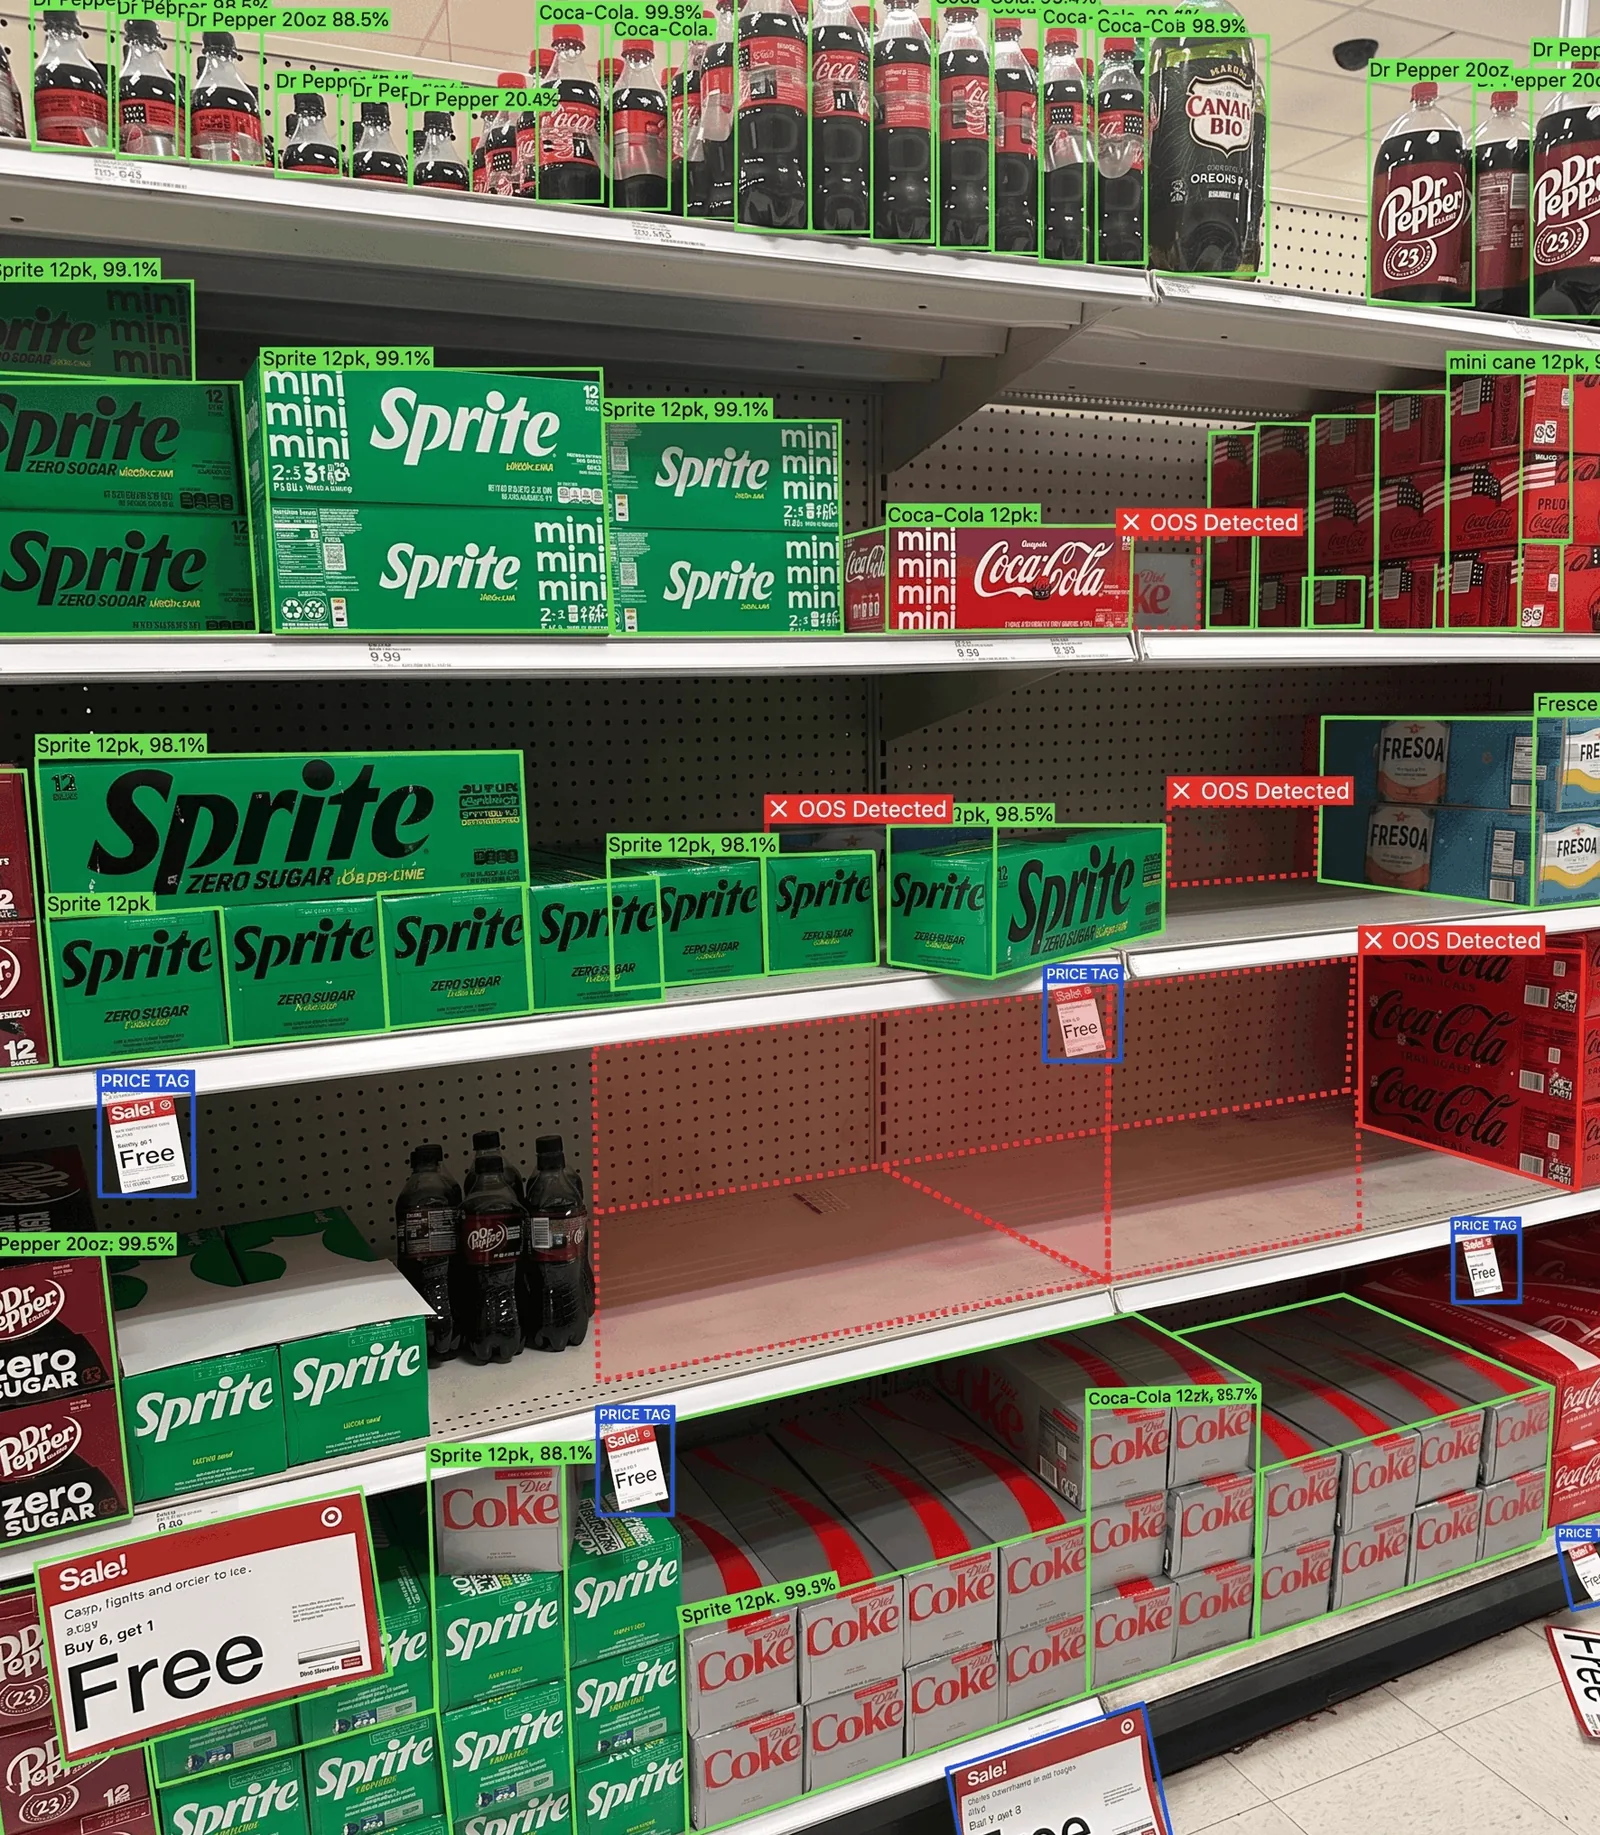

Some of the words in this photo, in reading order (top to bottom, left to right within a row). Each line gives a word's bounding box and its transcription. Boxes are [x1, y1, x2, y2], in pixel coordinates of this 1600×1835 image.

[1411, 176, 1449, 206] Dr
[1386, 187, 1463, 241] Pepper
[1398, 249, 1420, 268] 23
[1546, 232, 1570, 253] 23
[583, 385, 599, 399] 12
[266, 396, 347, 428] mini
[370, 387, 560, 466] Sprite
[269, 428, 349, 460] mini
[781, 424, 838, 450] mini
[26, 460, 65, 474] ZERO
[655, 446, 769, 497] Sprite
[783, 475, 838, 500] mini
[534, 516, 604, 544] mini
[1, 530, 207, 606] Sprite
[379, 543, 521, 600] Sprite
[537, 545, 605, 573] mini
[898, 553, 957, 578] mini
[539, 574, 606, 601] mini
[663, 560, 775, 610] Sprite
[898, 579, 957, 604] mini
[898, 605, 957, 629] mini
[370, 651, 401, 663] 9.99
[87, 759, 435, 895] Sprite
[185, 871, 250, 894] ZERO
[253, 866, 335, 890] SUGAR
[891, 872, 985, 917] Sprite
[1007, 845, 1135, 956] Sprite
[539, 894, 657, 953] Sprite
[61, 929, 213, 997] Sprite
[233, 917, 377, 980] Sprite
[104, 1008, 141, 1023] ZERO
[1063, 1023, 1097, 1038] Free
[4, 1039, 37, 1060] 12
[111, 1101, 155, 1121] Sale!
[120, 1148, 175, 1169] Free
[1471, 1268, 1496, 1280] Free
[293, 1340, 421, 1407] Sprite
[135, 1374, 274, 1443] Sprite
[20, 1424, 52, 1451] Dr
[608, 1430, 640, 1448] Sale!
[1177, 1407, 1250, 1449] Coke
[0, 1425, 75, 1477] Pepper
[1421, 1430, 1481, 1468] Coke
[616, 1469, 657, 1489] Free
[1268, 1475, 1338, 1517] Coke
[2, 1482, 93, 1521] zero
[5, 1502, 96, 1537] SUGAR
[443, 1485, 560, 1530] Coke
[1182, 1494, 1255, 1538] Coke
[1342, 1532, 1407, 1574] Coke
[59, 1553, 128, 1591] Sale!
[148, 1582, 172, 1597] and
[214, 1571, 227, 1581] to
[573, 1557, 678, 1616] Sprite
[909, 1572, 995, 1622] Coke
[64, 1639, 95, 1656] Buy
[117, 1623, 143, 1643] get
[146, 1620, 154, 1631] 1
[446, 1597, 558, 1662] Sprite
[698, 1635, 795, 1691] Coke
[67, 1634, 264, 1732] Free
[576, 1657, 677, 1719] Sprite
[315, 1733, 434, 1801] Sprite
[967, 1760, 1008, 1786] Sale!
